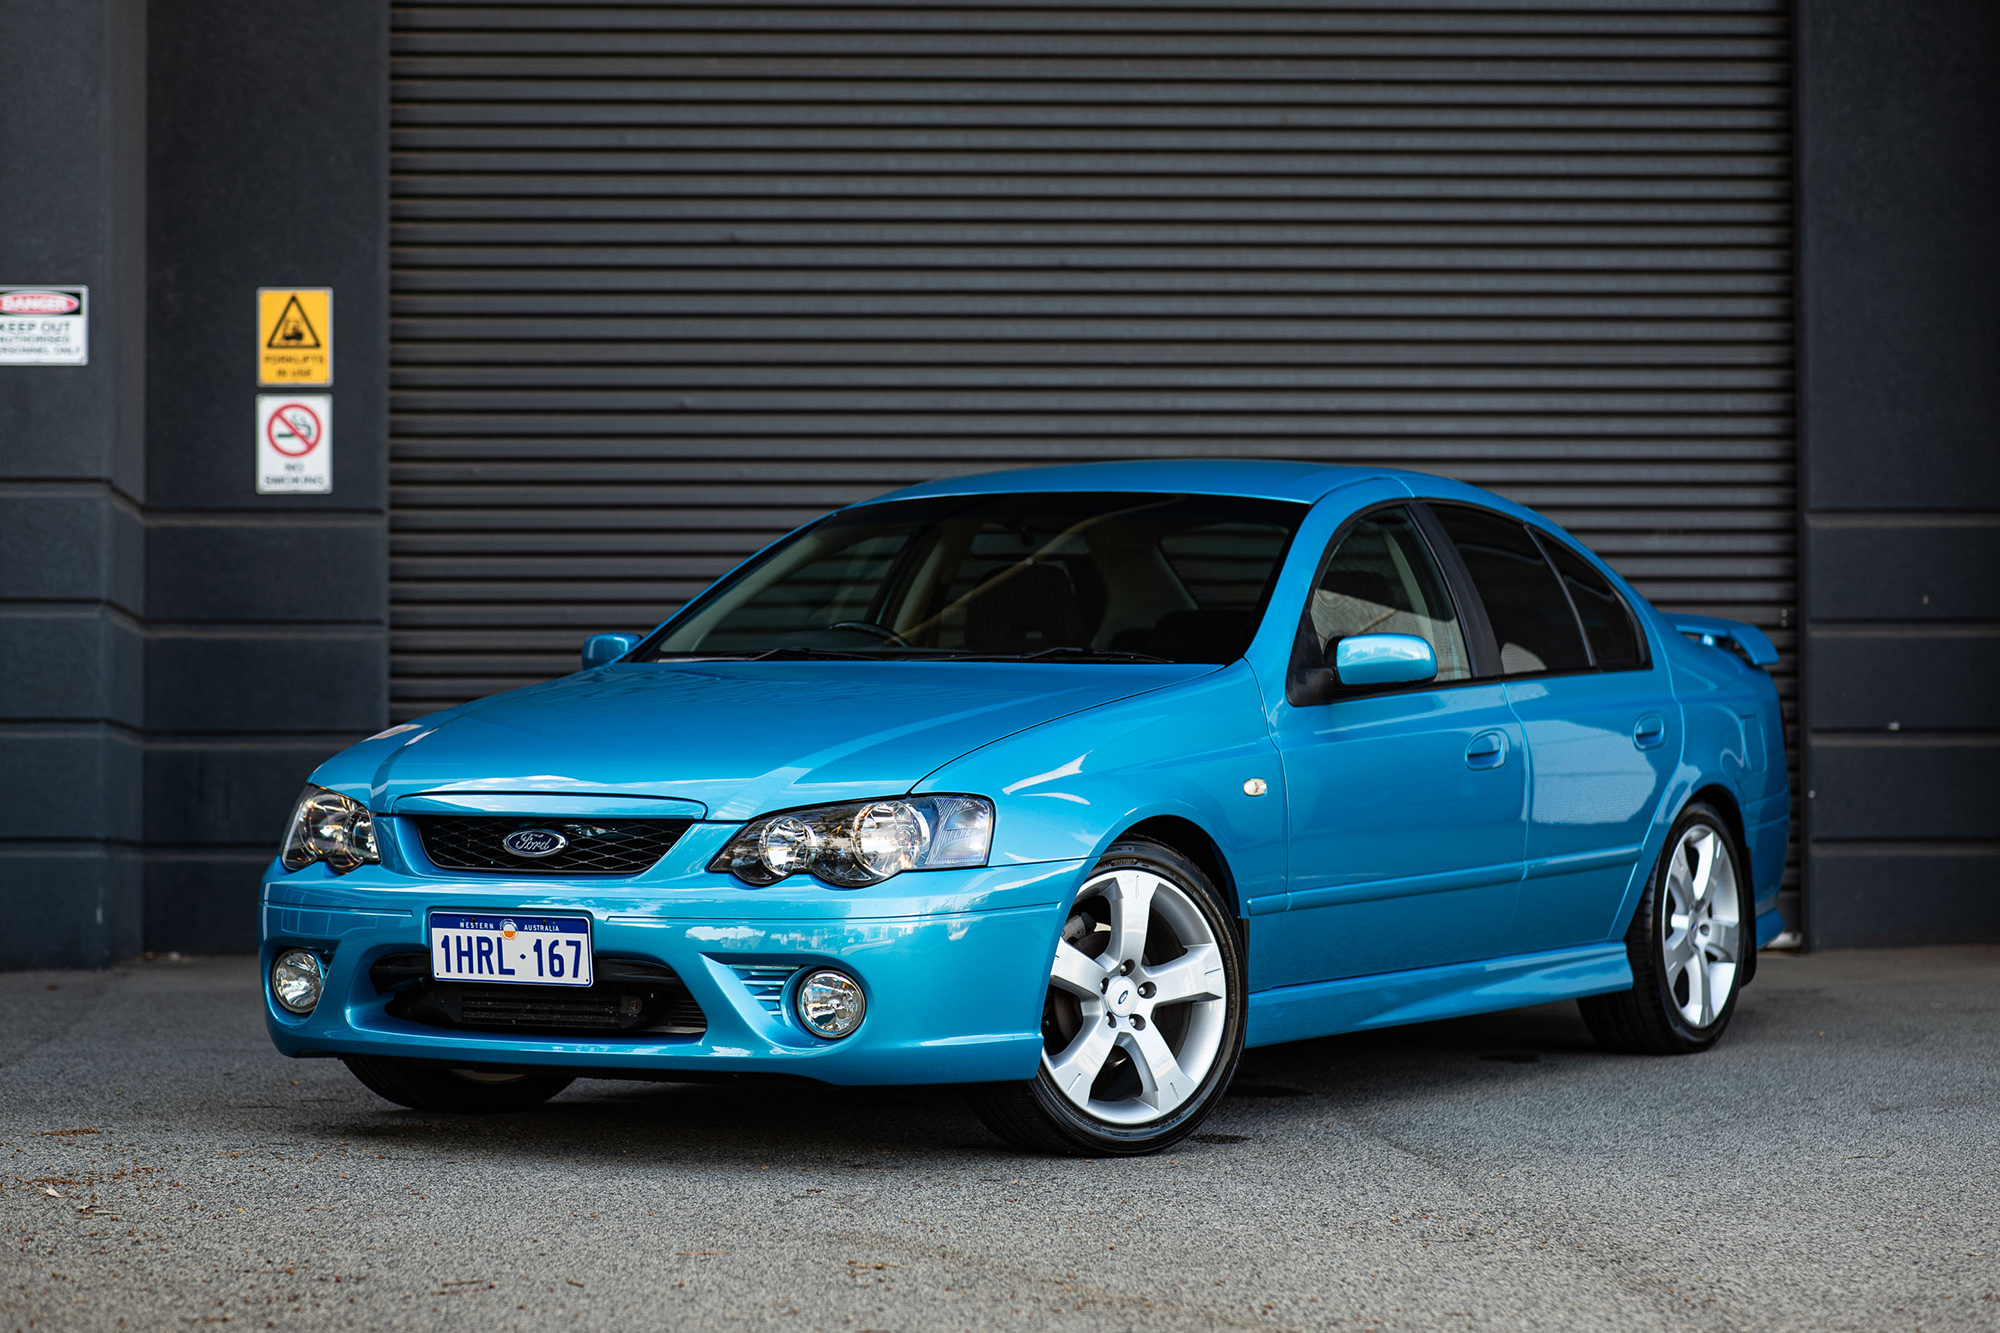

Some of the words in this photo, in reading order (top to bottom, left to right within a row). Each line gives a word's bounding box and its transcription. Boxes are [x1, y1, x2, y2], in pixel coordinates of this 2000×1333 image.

[2, 296, 68, 311] DANGER
[41, 321, 71, 333] OUT
[284, 461, 305, 472] NO
[265, 474, 324, 486] SMOKING
[514, 832, 552, 851] Ford
[459, 921, 494, 930] WESTERN
[523, 924, 560, 932] AUSTRALIA
